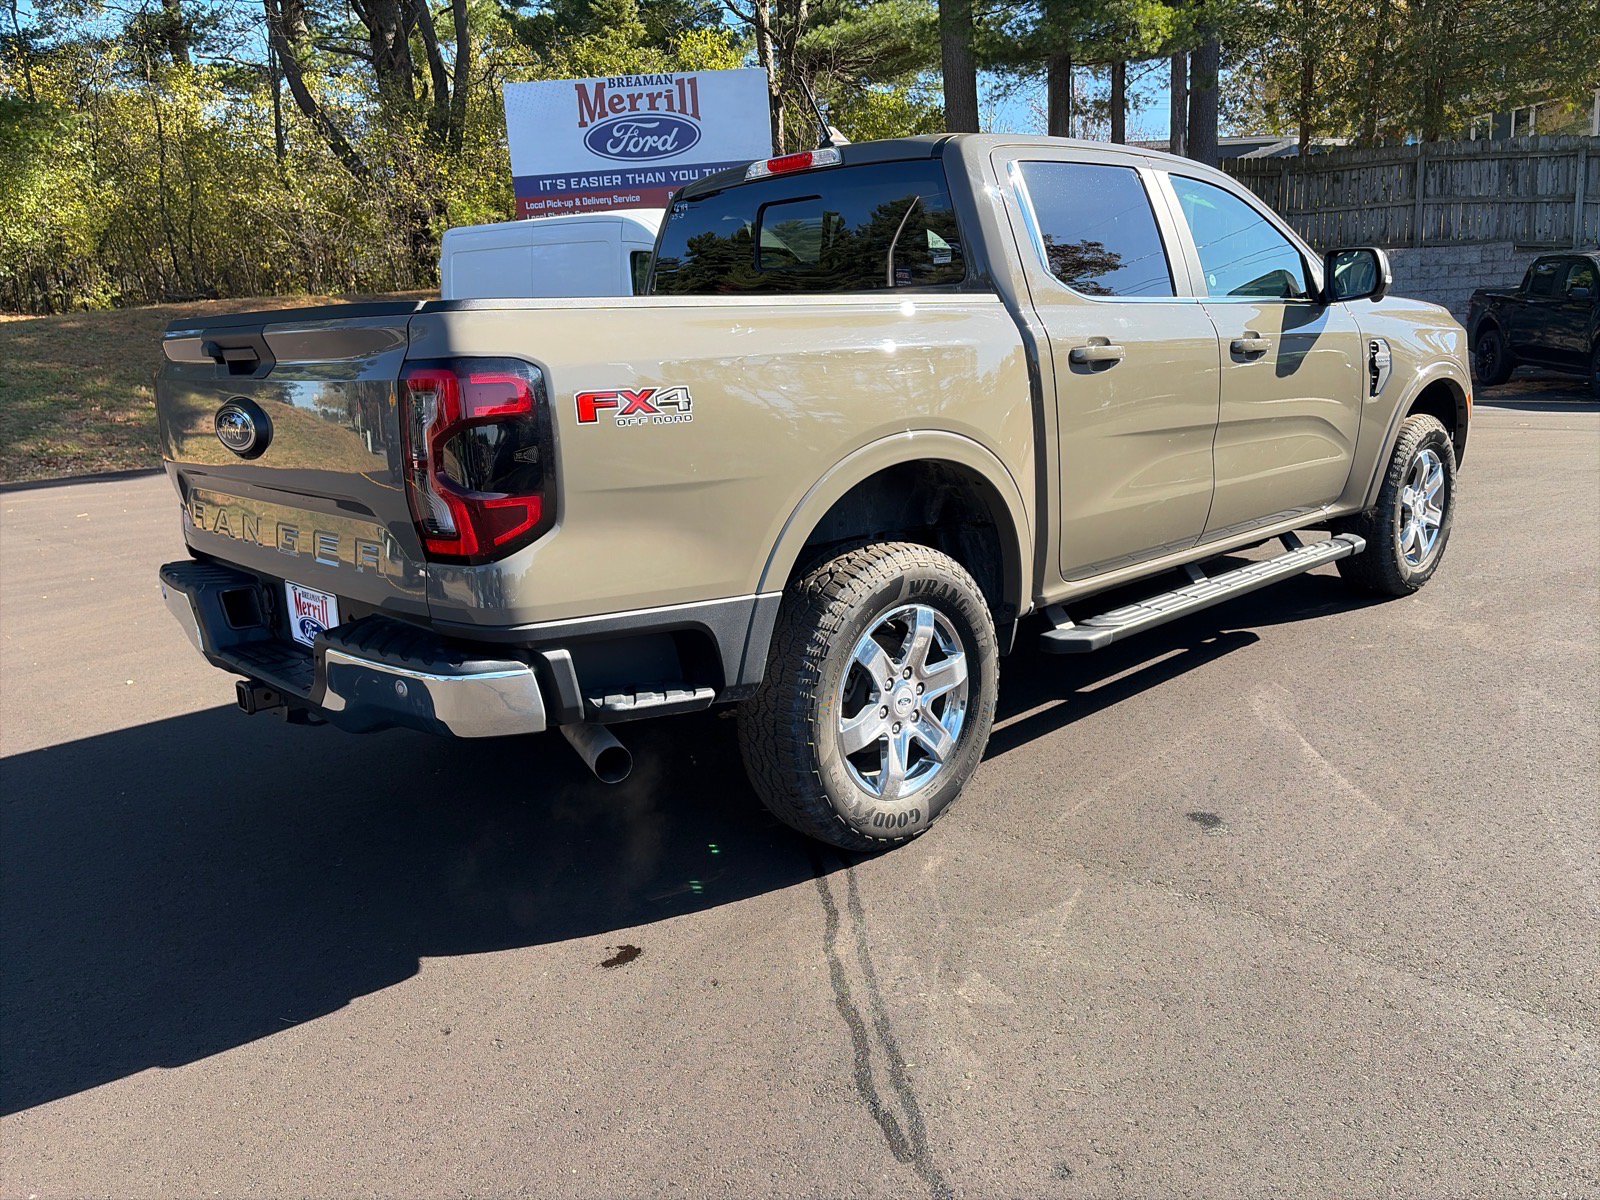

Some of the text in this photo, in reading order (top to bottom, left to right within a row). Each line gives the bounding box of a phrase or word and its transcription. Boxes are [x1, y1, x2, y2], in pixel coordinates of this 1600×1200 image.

[607, 74, 673, 89] BREAMAN
[575, 76, 701, 128] Merrill
[606, 121, 678, 154] Ford
[539, 179, 567, 191] IT'S
[571, 175, 622, 189] EASIER
[626, 172, 666, 184] THAN
[670, 169, 699, 181] YOU
[525, 194, 641, 210] Local Pick-up & Delivery Service
[574, 385, 693, 425] FX4
[617, 414, 694, 427] OFF ROAD
[191, 501, 388, 578] RANGER
[293, 590, 330, 629] Merrill
[873, 808, 921, 829] GOOD
